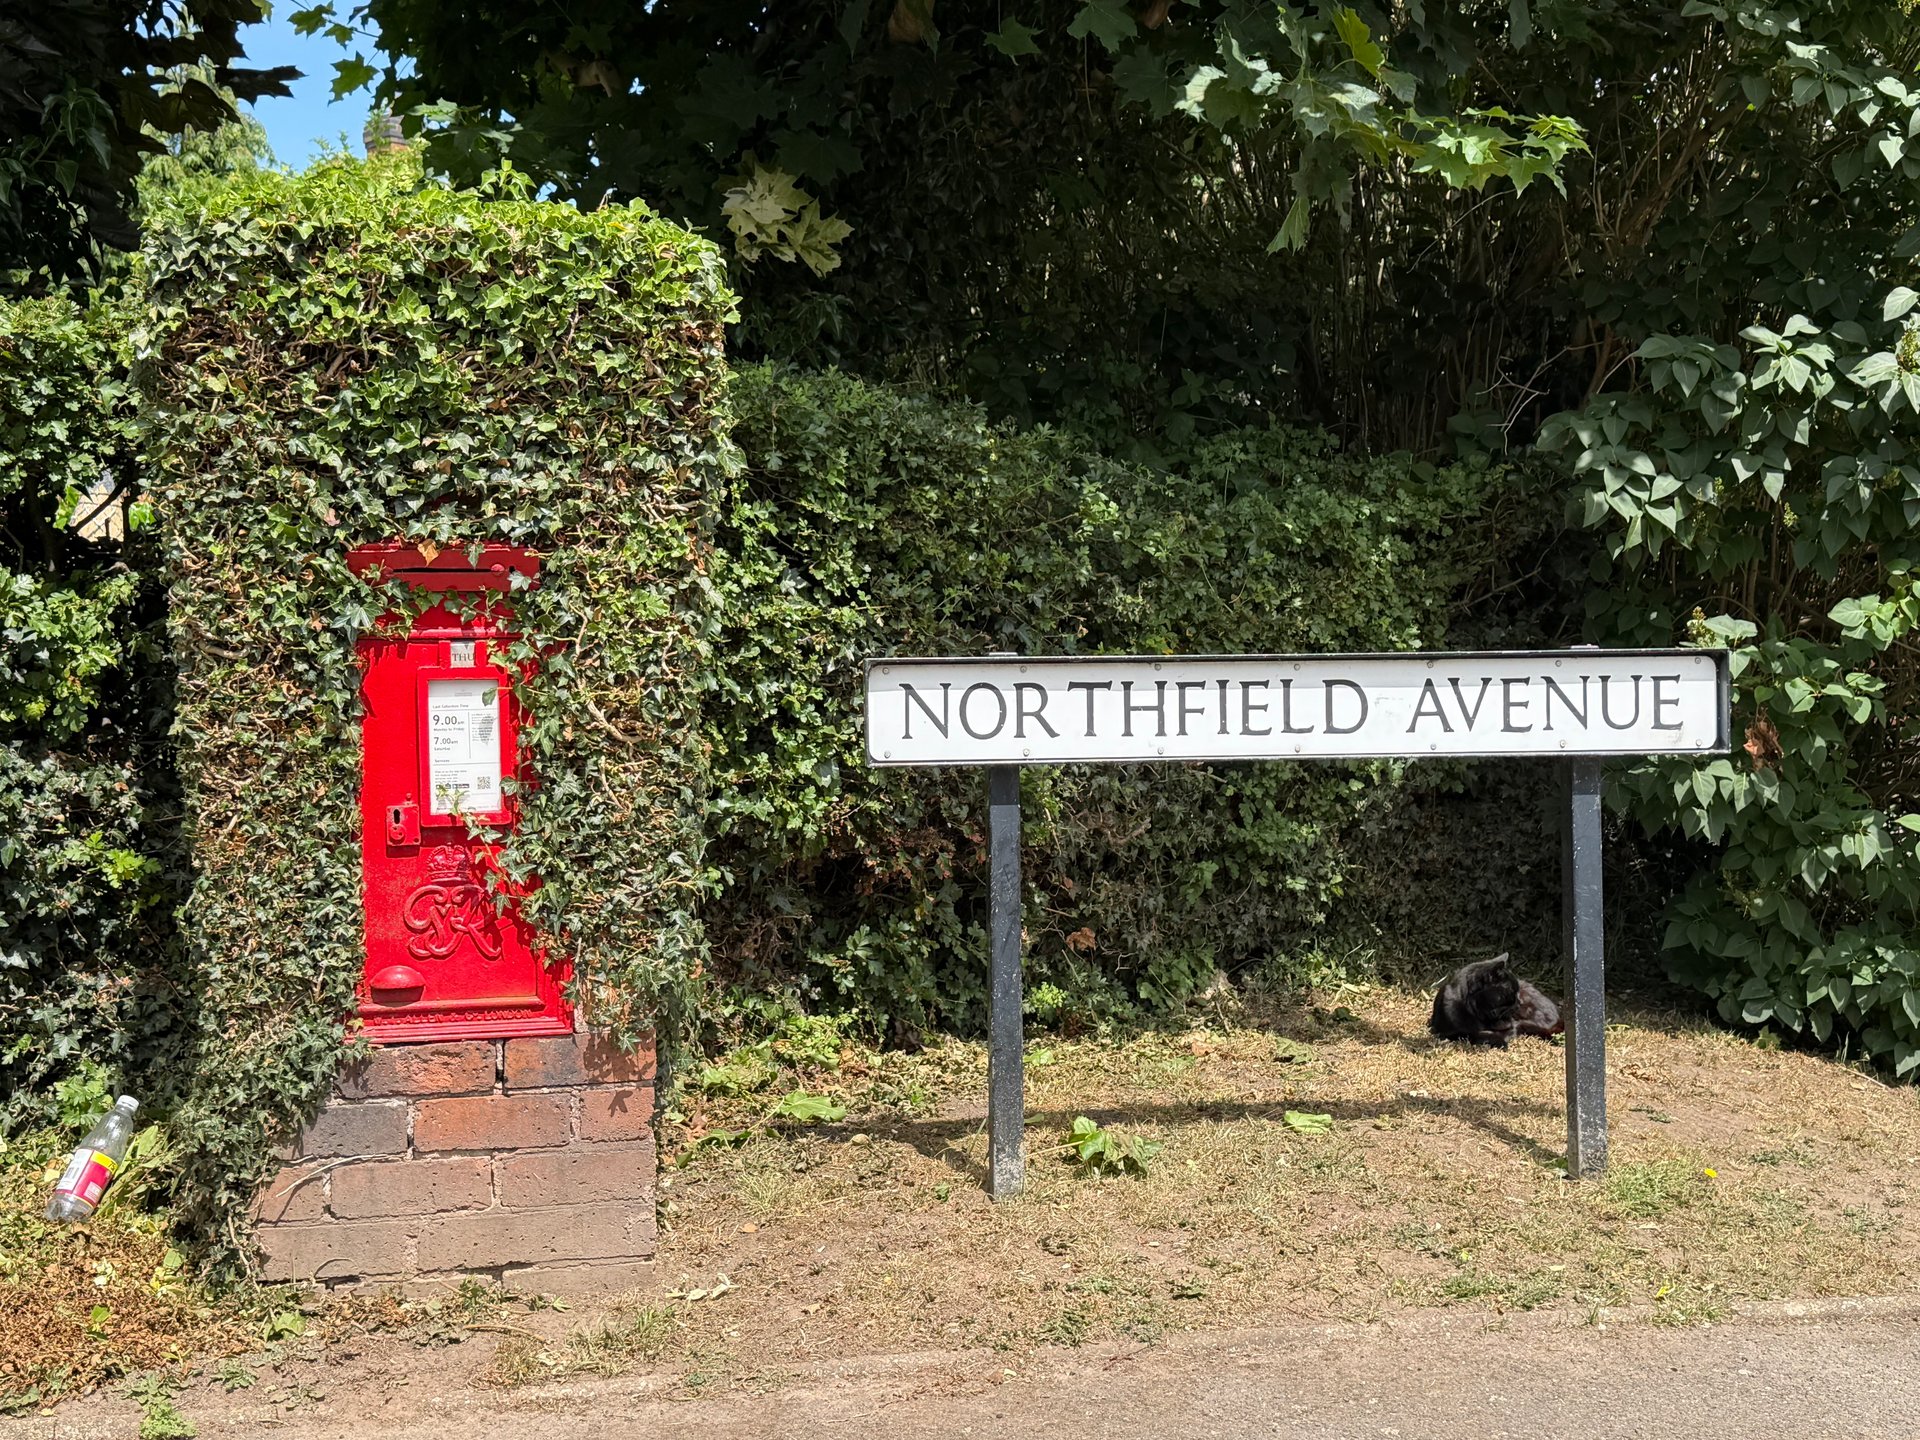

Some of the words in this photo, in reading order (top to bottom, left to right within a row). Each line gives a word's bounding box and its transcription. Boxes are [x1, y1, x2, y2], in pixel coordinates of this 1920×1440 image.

[452, 653, 474, 661] THU
[898, 678, 1369, 740] NORTHFIELD
[1405, 674, 1684, 734] AVENUE
[433, 714, 464, 726] 9.00am
[433, 737, 459, 745] 7.00am
